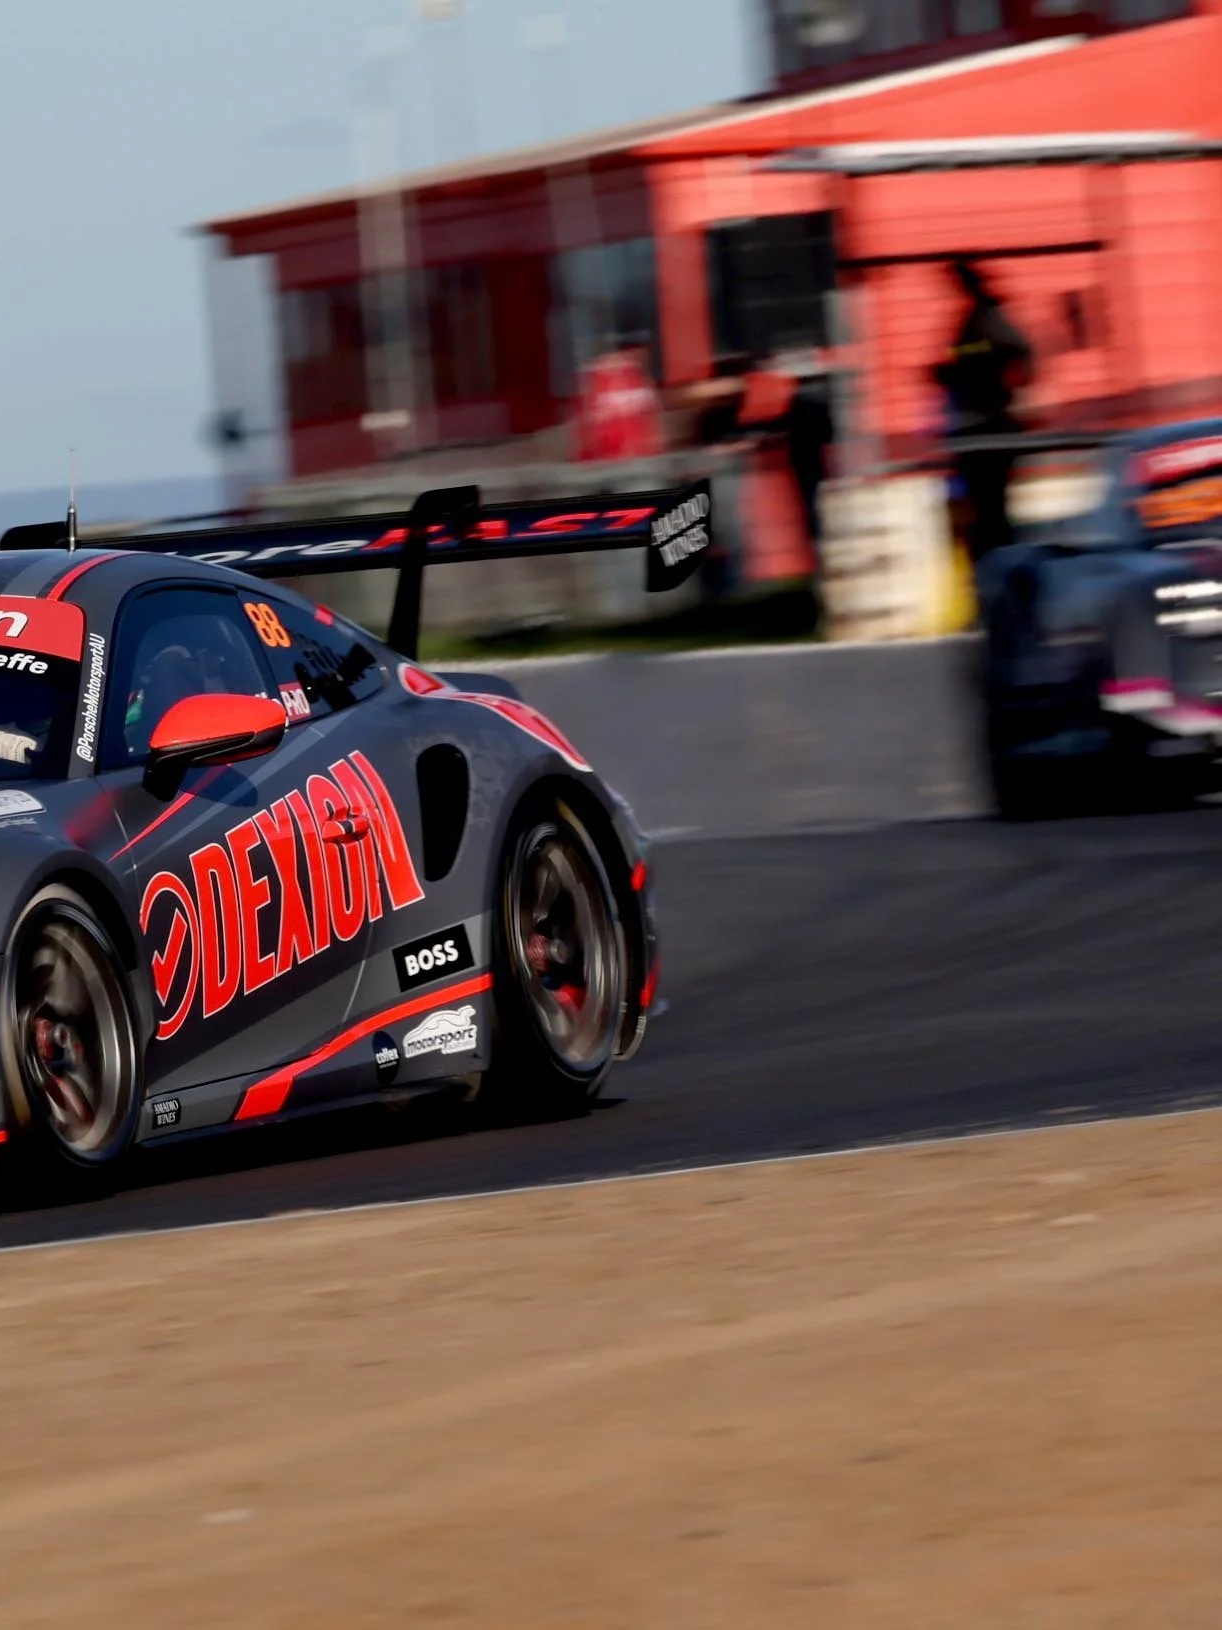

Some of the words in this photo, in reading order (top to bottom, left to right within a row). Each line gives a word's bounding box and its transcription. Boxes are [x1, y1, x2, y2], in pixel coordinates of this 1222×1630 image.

[243, 602, 291, 648] 88
[76, 633, 106, 762] @PorscheMotorsportAU
[280, 688, 311, 716] PRO
[189, 750, 425, 1019] DEXION
[404, 940, 459, 977] BOSS
[406, 1027, 474, 1057] motorsport
